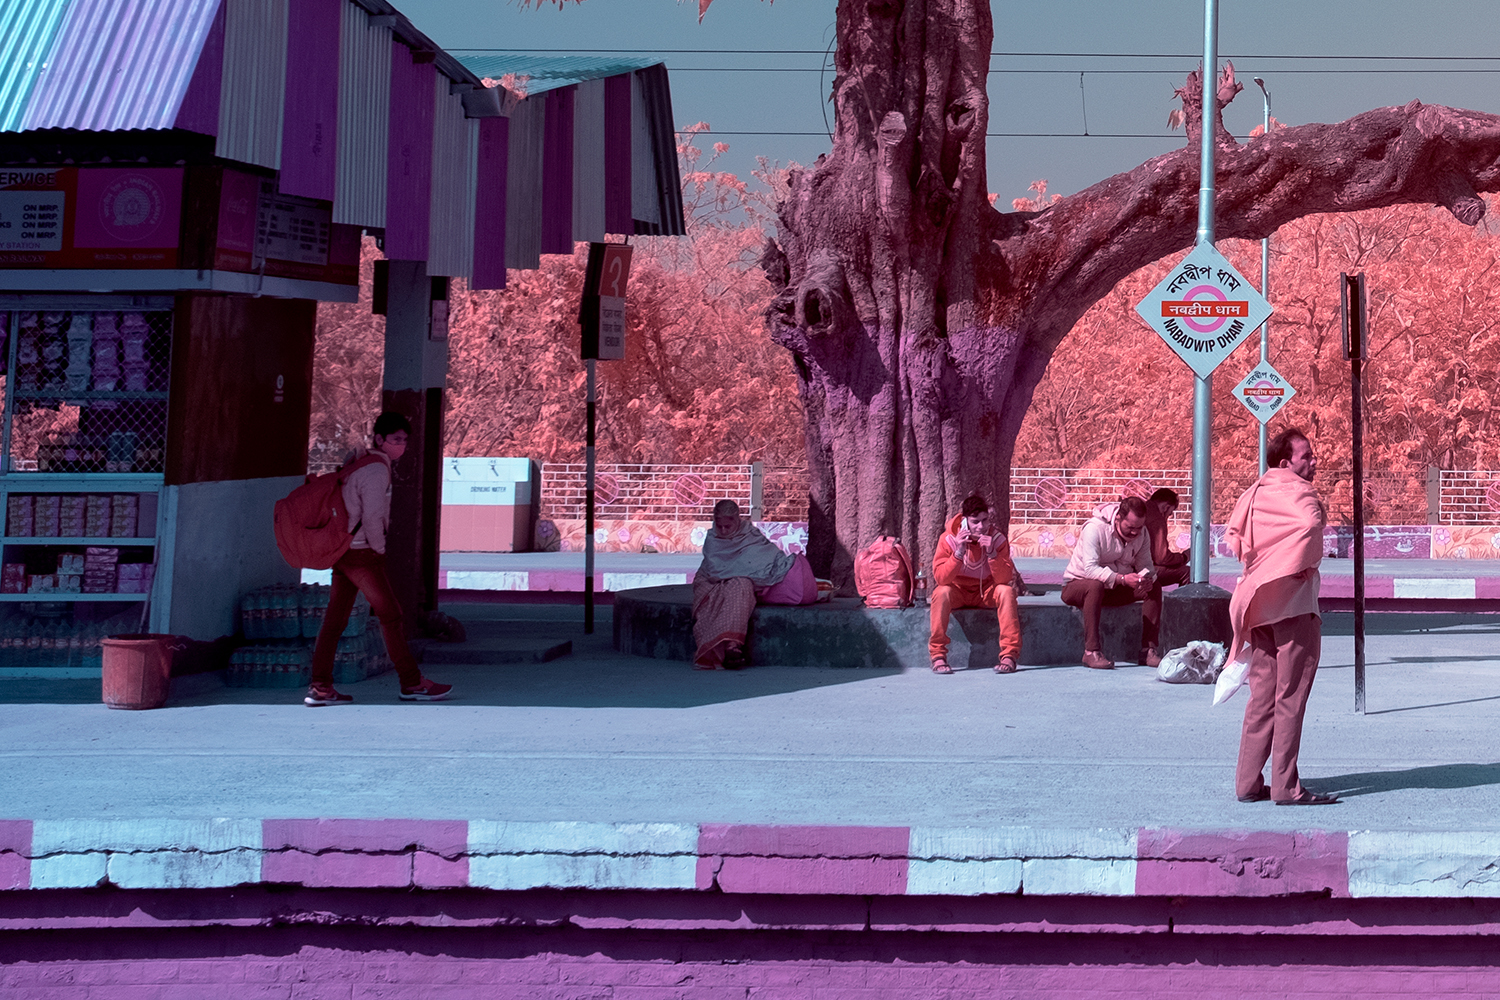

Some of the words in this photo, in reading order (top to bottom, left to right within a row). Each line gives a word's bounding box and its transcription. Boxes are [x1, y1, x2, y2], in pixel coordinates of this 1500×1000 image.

[23, 204, 37, 212] ON
[22, 221, 36, 229] ON
[20, 231, 35, 239] ON
[1166, 264, 1212, 294] নবদ্বীপ
[1216, 269, 1241, 292] ধাম
[1169, 302, 1212, 316] नवद्वीप
[1215, 305, 1241, 316] धाम
[1163, 318, 1216, 353] NABADWIP
[1216, 319, 1245, 349] DHAM
